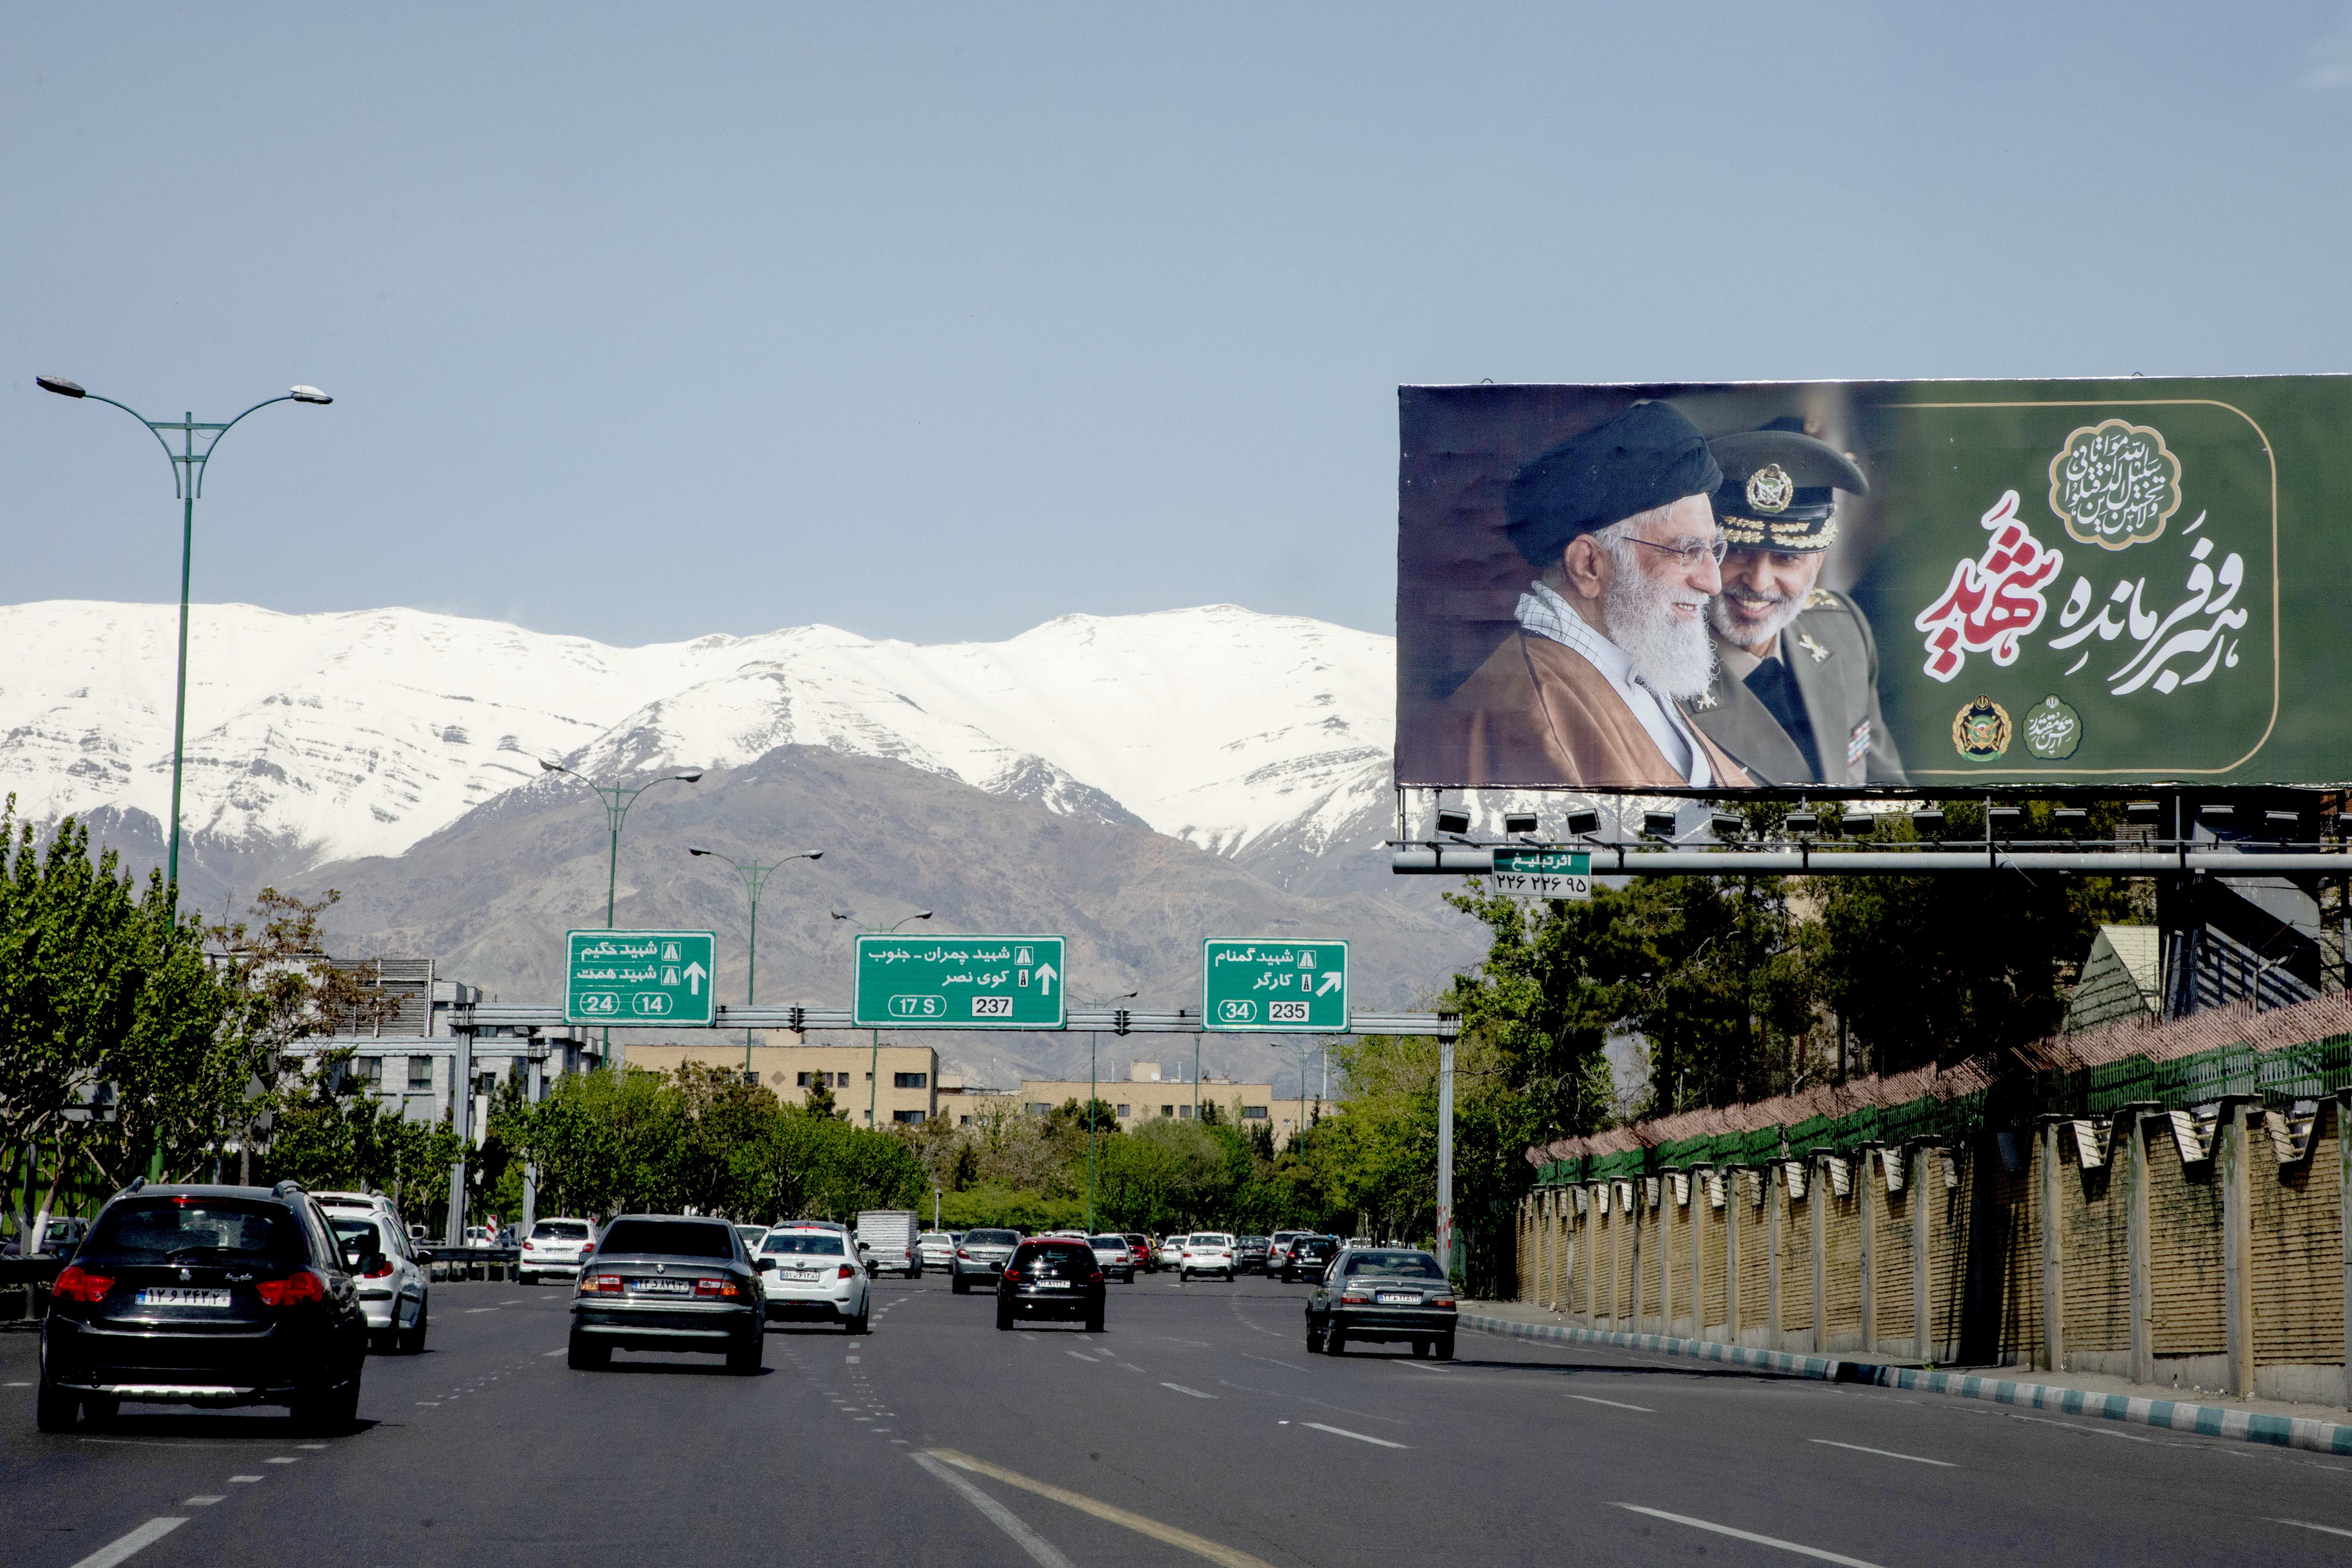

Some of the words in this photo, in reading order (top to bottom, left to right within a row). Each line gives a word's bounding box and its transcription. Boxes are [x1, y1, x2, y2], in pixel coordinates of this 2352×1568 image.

[1917, 491, 2062, 682] شهید
[2049, 519, 2214, 681] فرمانده
[1496, 874, 1526, 889] ۲۲۶
[1531, 876, 1561, 891] ۲۲۶
[1566, 877, 1587, 893] ۹۵
[581, 941, 617, 961] حکیم
[620, 940, 658, 958] شهید
[868, 948, 911, 964] جنوب
[924, 946, 969, 965] چمران
[972, 946, 1010, 962] شهید
[1215, 947, 1256, 967] گمنام
[1256, 949, 1294, 966] شهید
[576, 968, 617, 980] همت
[619, 965, 657, 982] شهید
[941, 971, 973, 987] نصر
[977, 970, 1010, 988] کوی
[1253, 971, 1293, 991] کارگر
[587, 995, 613, 1012] 24
[642, 996, 663, 1013] 14
[899, 998, 917, 1014] 17
[923, 998, 935, 1014] S
[976, 999, 1010, 1014] 237
[1225, 1002, 1249, 1019] 34
[1272, 1004, 1305, 1019] 235
